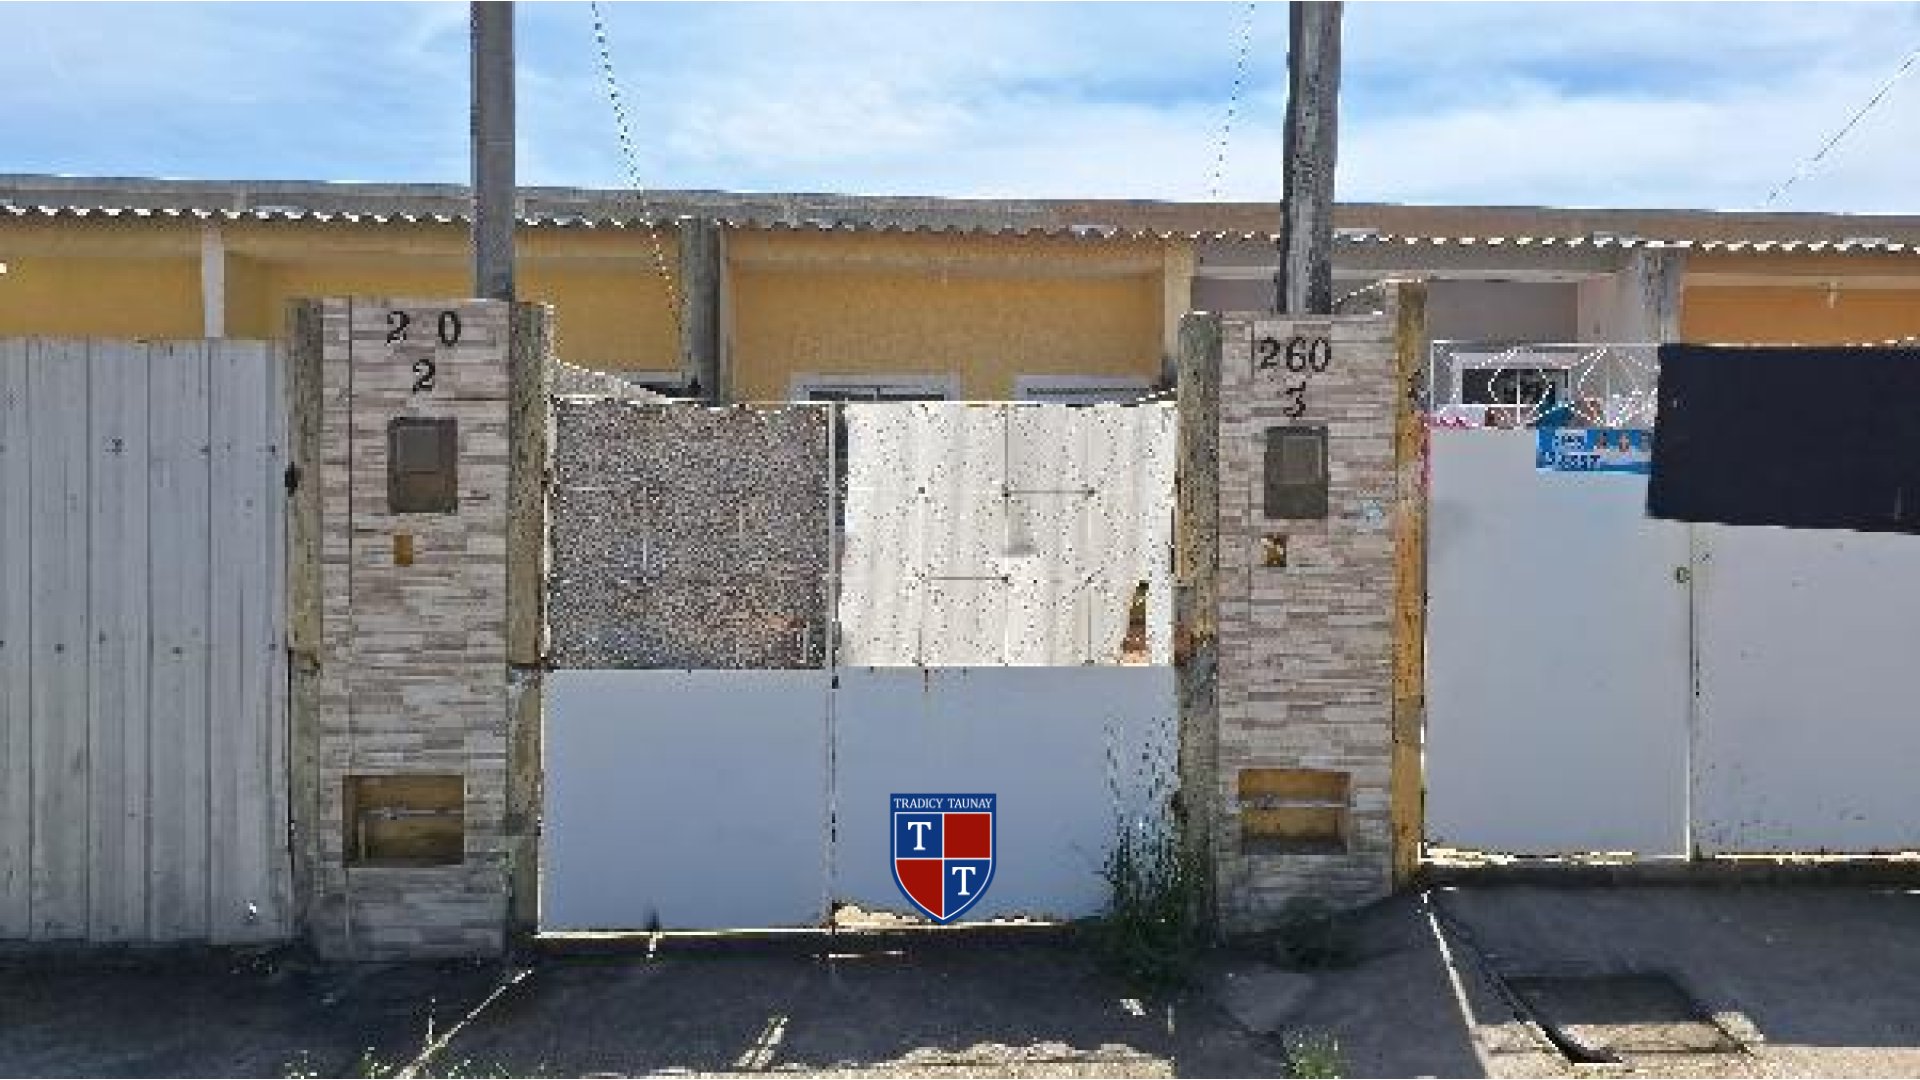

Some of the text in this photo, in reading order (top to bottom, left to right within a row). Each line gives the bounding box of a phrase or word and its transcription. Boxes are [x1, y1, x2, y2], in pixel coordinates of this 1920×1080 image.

[1260, 336, 1332, 373] 260
[412, 358, 436, 394] 2
[1282, 381, 1306, 420] 3
